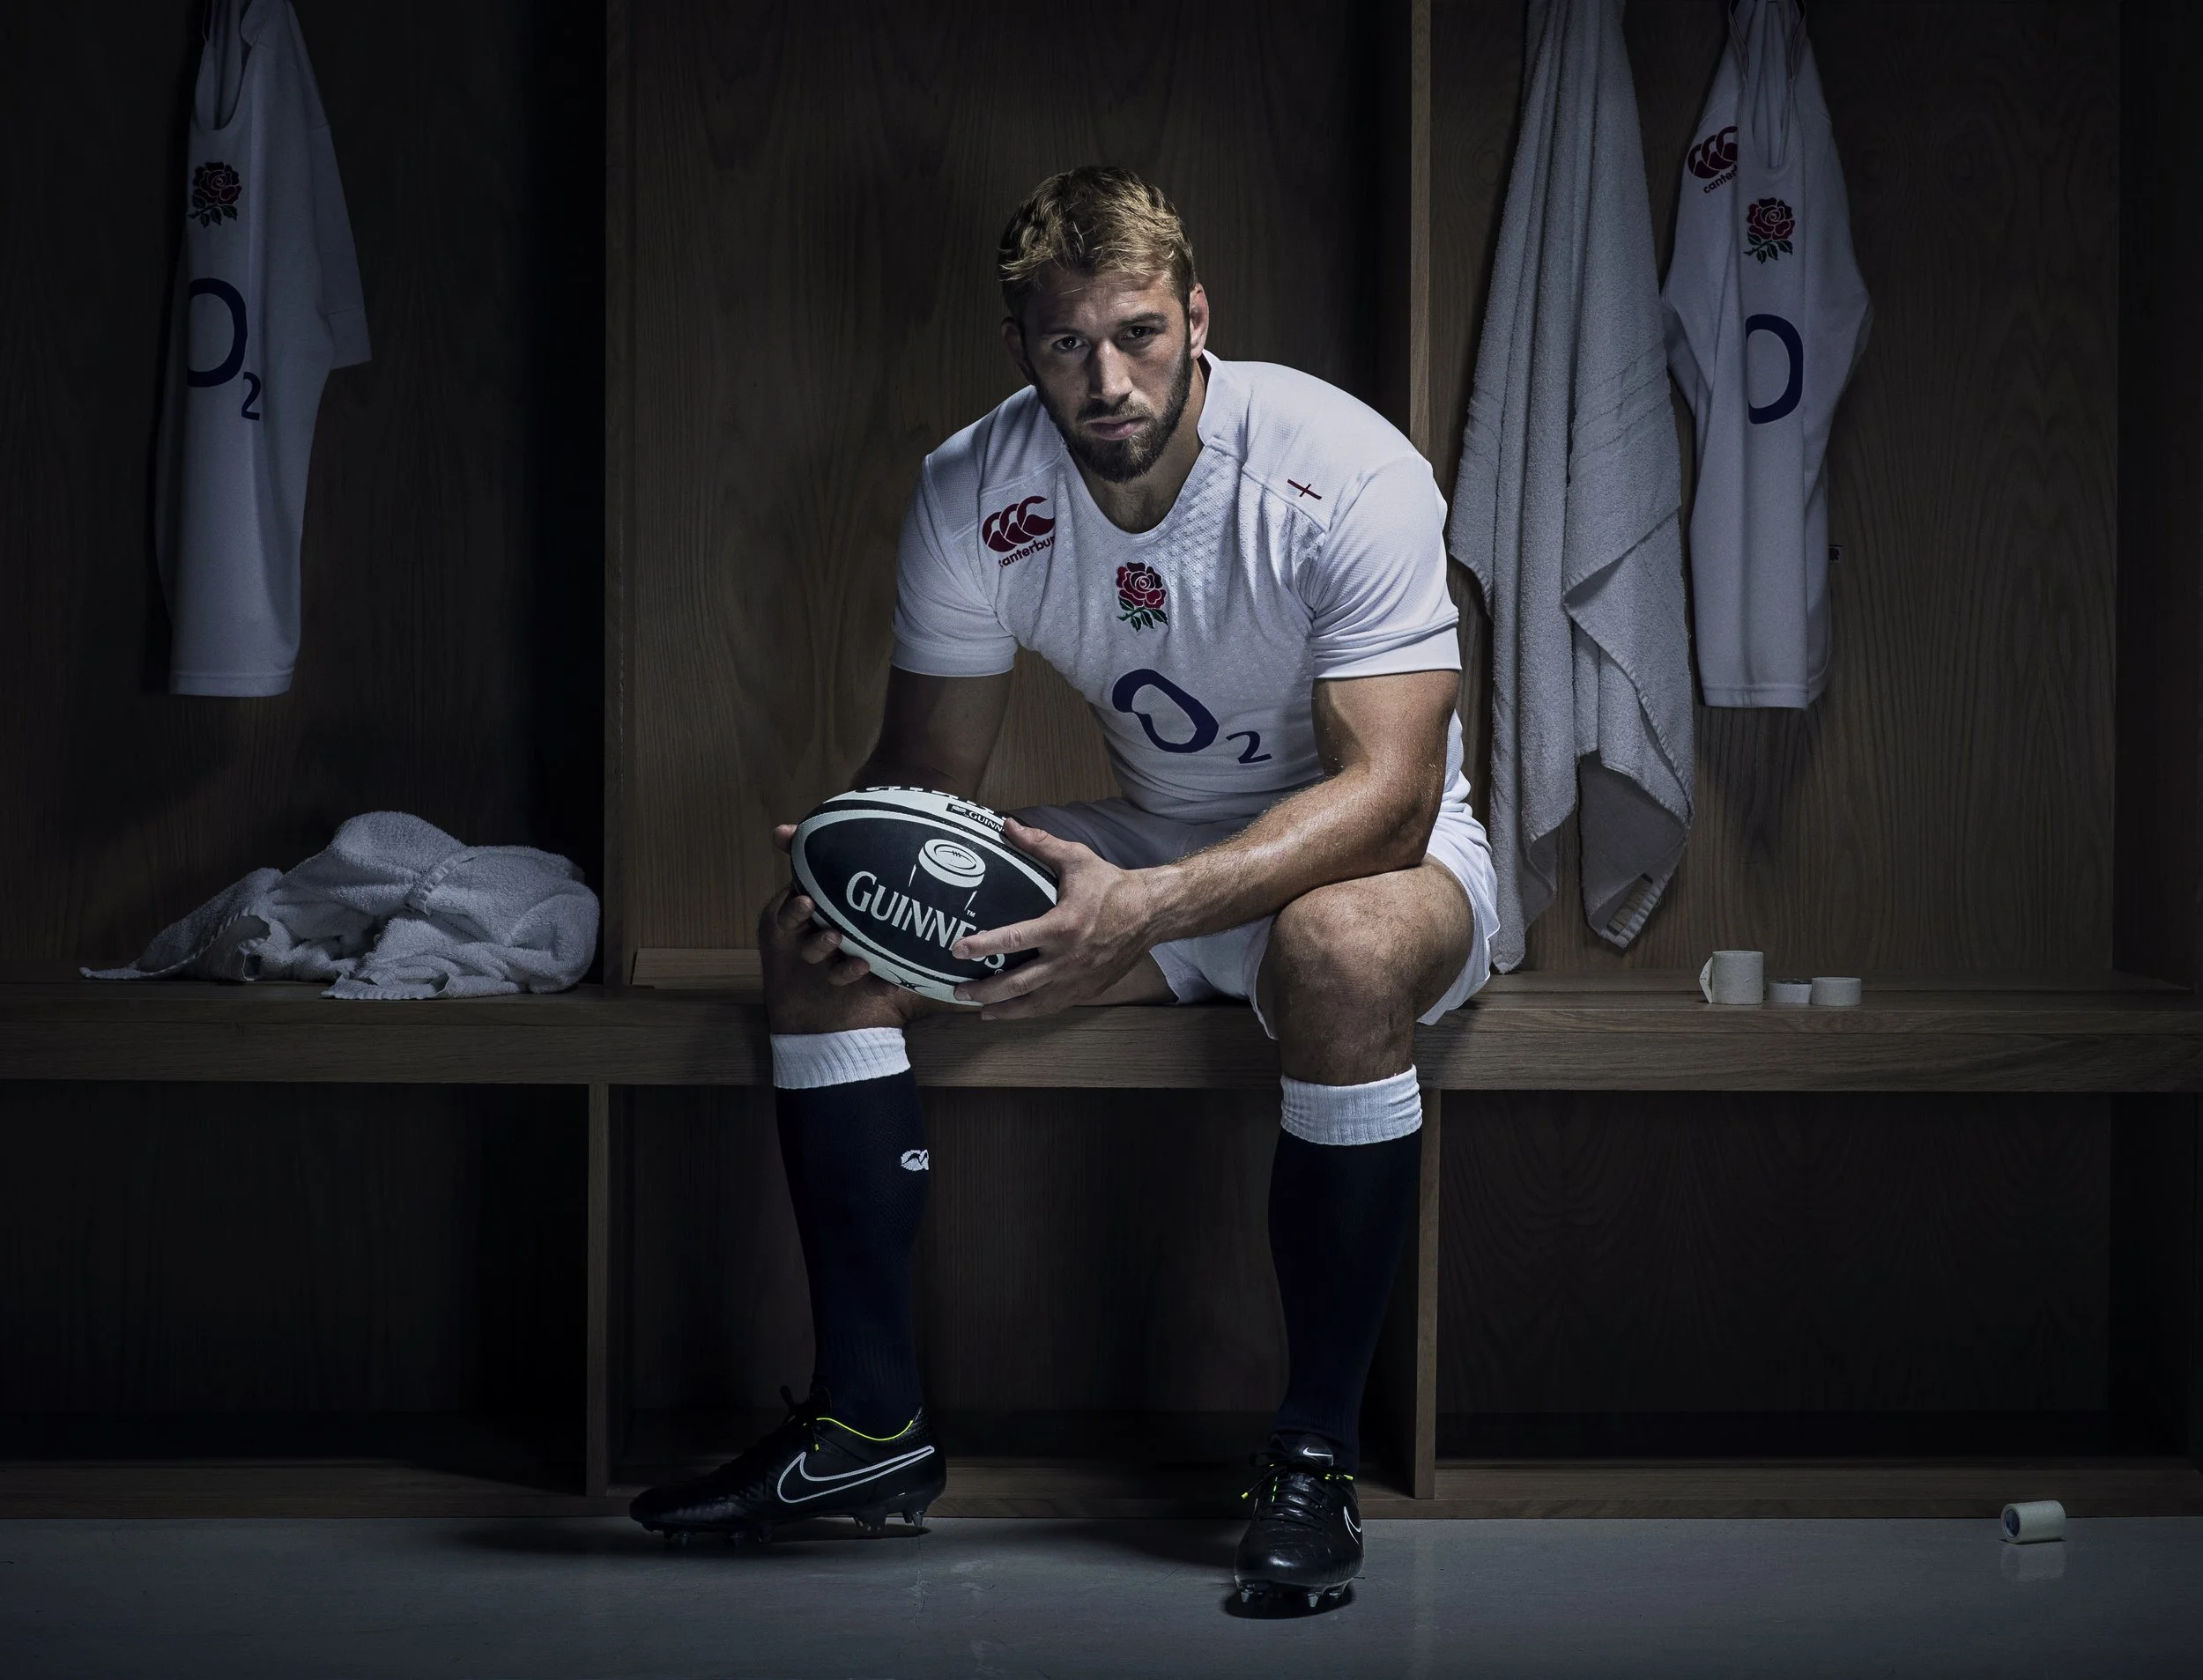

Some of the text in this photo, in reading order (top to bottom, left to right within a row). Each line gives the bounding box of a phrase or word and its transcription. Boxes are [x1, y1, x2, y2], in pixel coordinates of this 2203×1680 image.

[1703, 165, 1737, 193] canter
[1112, 668, 1272, 765] O2
[968, 811, 1005, 833] GUINN
[846, 870, 1005, 969] GUINNES
